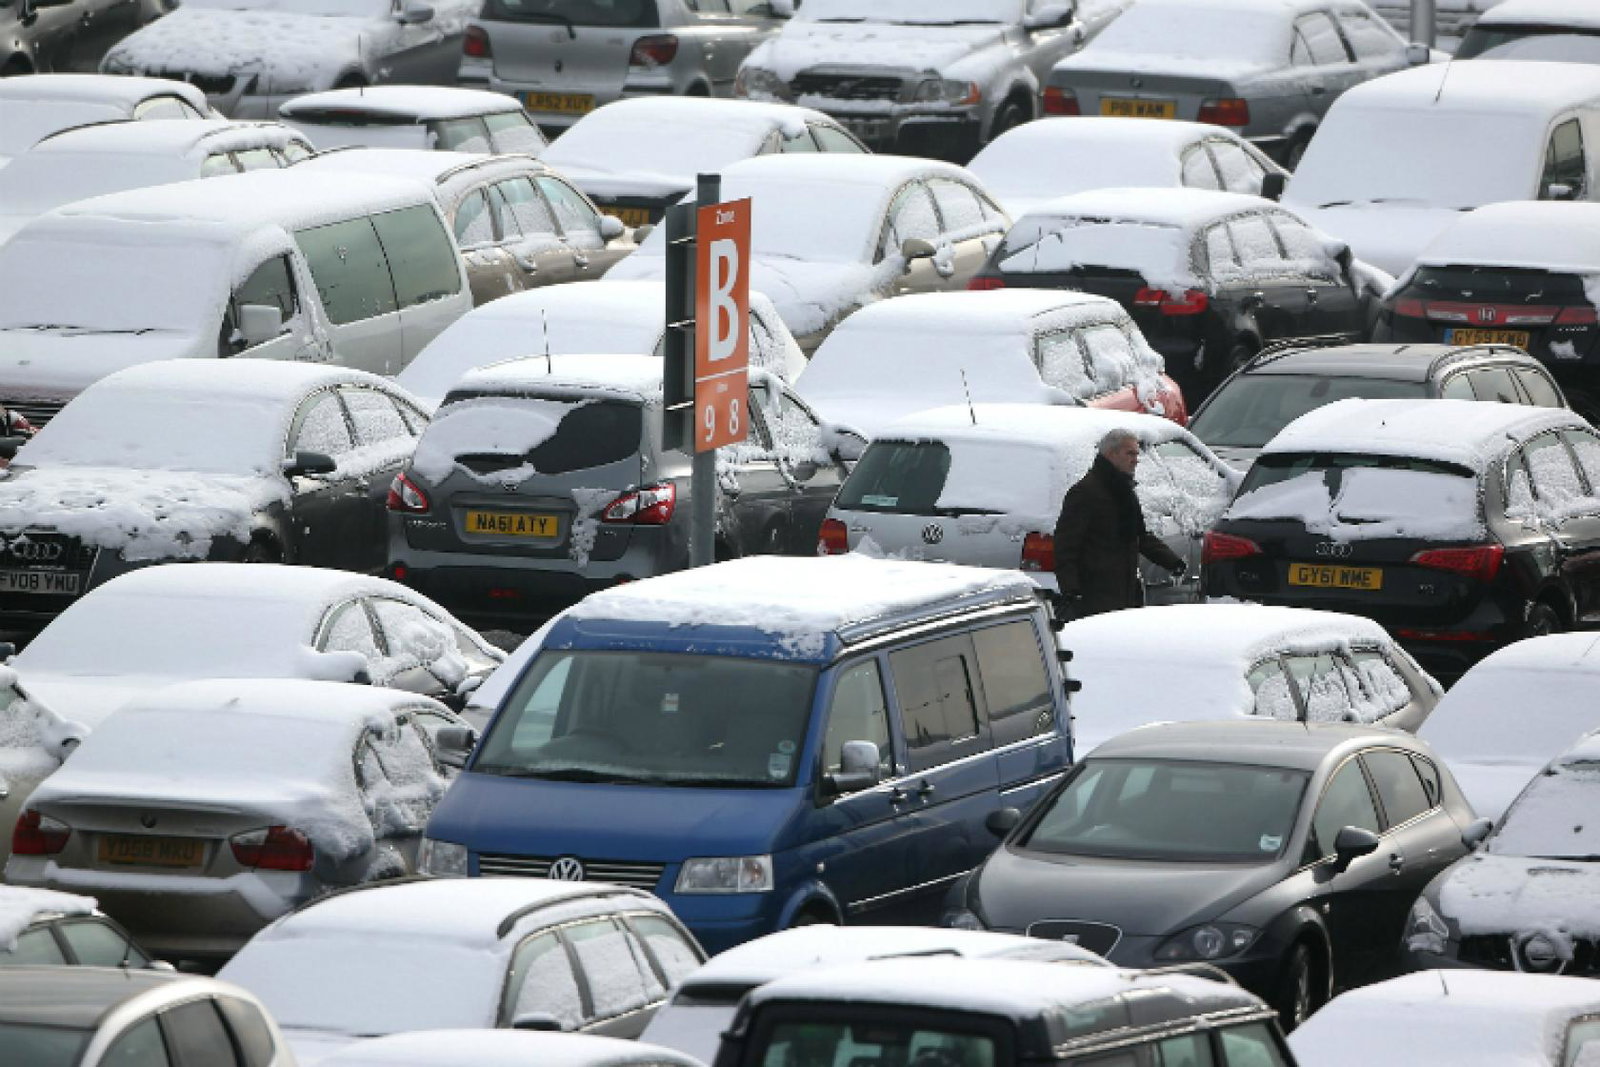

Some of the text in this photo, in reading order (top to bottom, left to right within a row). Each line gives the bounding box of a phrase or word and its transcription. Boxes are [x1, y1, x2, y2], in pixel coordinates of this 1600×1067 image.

[708, 238, 739, 362] B
[705, 399, 739, 442] 9 8
[477, 513, 548, 534] NA61 ATY
[1298, 566, 1336, 584] GY61
